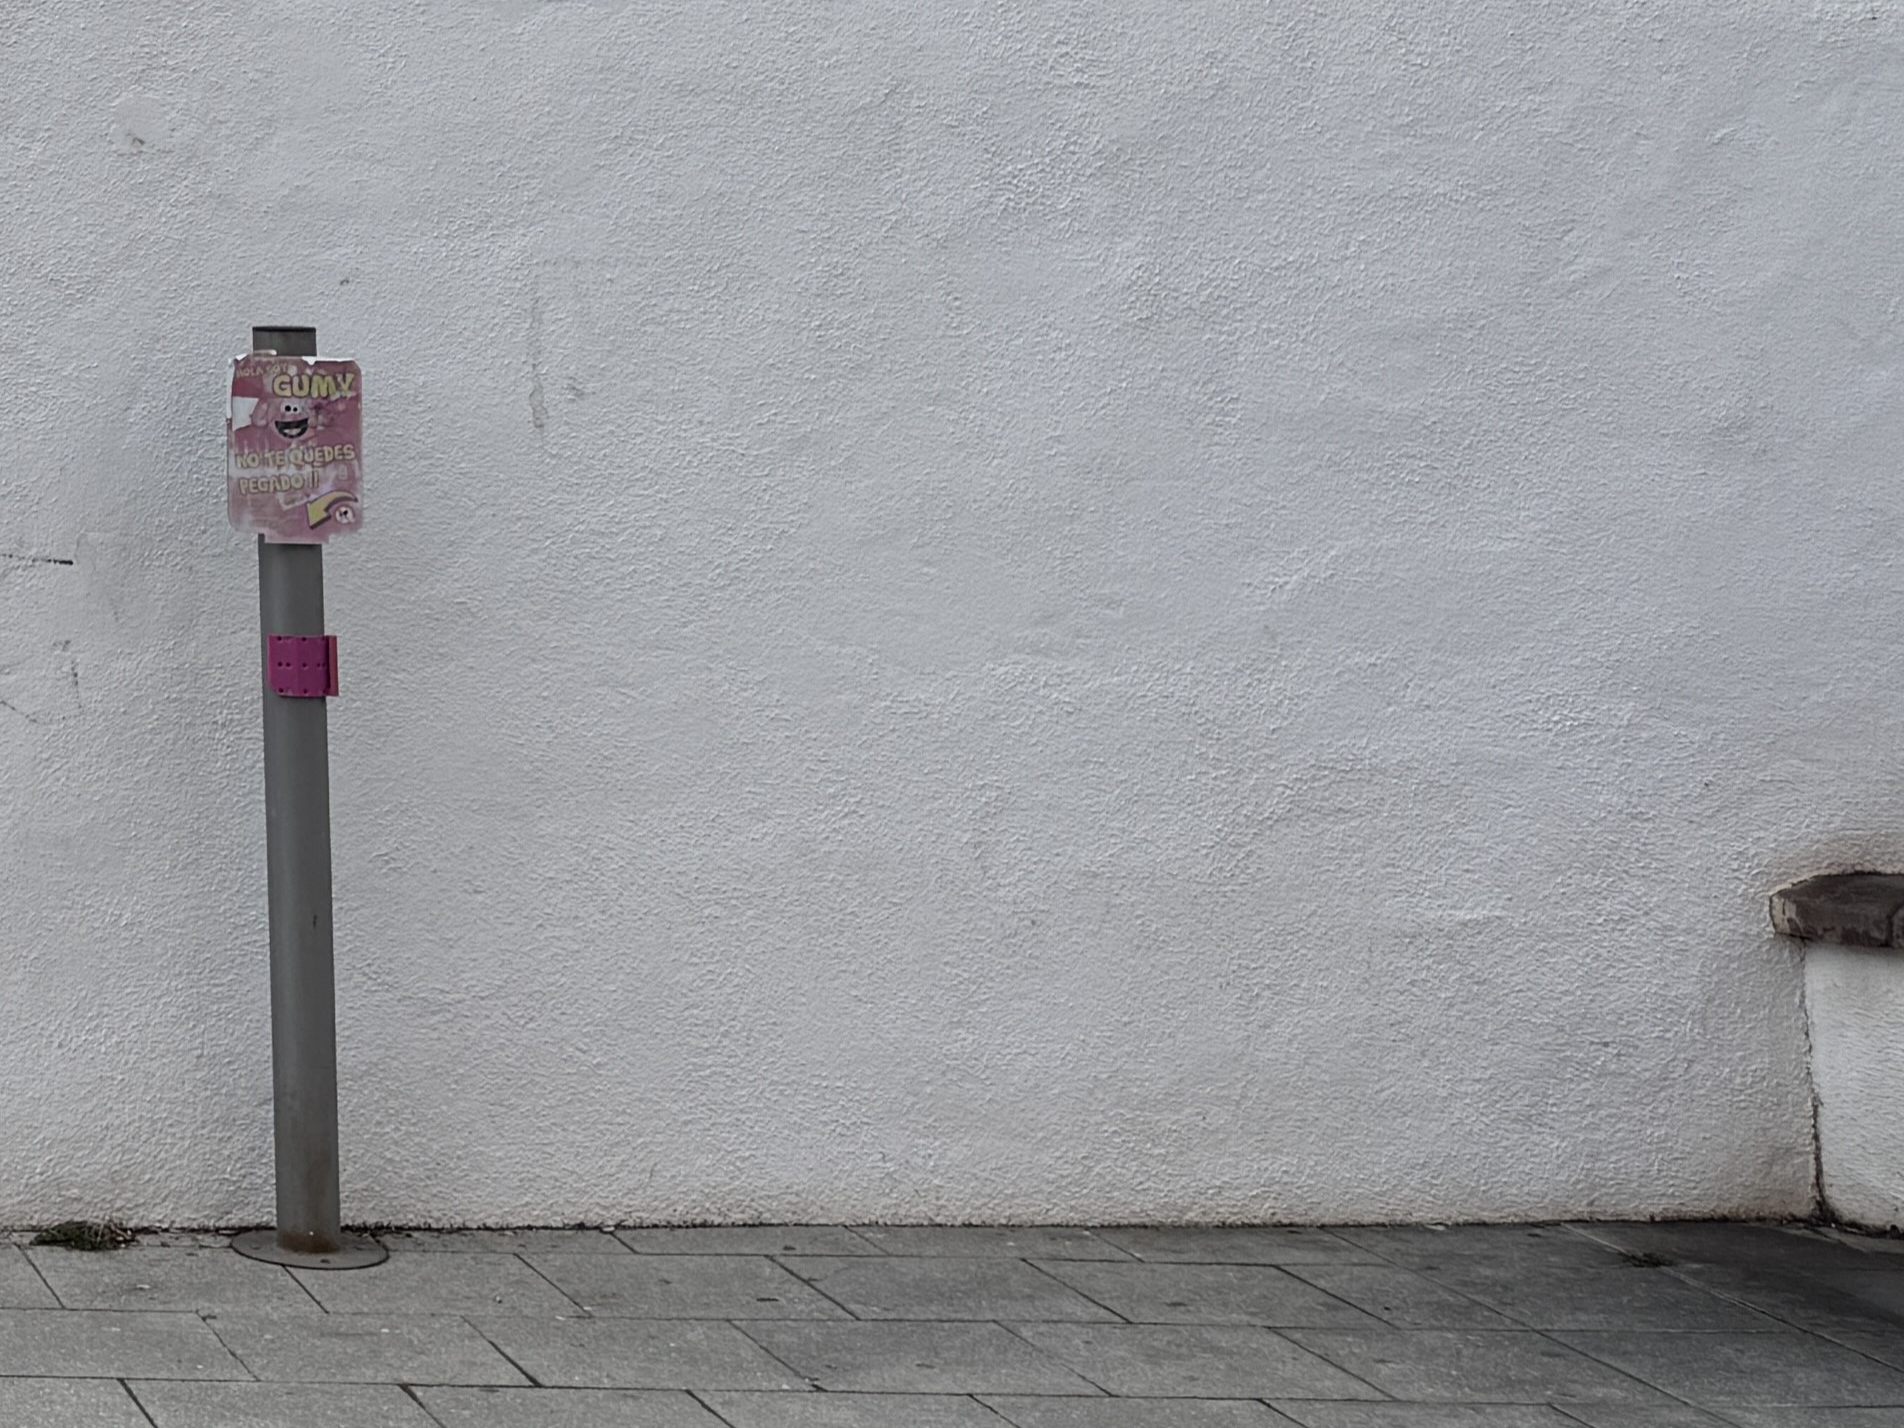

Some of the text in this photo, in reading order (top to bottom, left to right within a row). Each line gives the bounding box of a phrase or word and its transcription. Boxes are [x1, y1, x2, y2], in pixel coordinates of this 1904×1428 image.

[273, 373, 354, 399] GUMY
[235, 444, 356, 469] NO TE QUEDES
[238, 473, 305, 494] PEGADO
